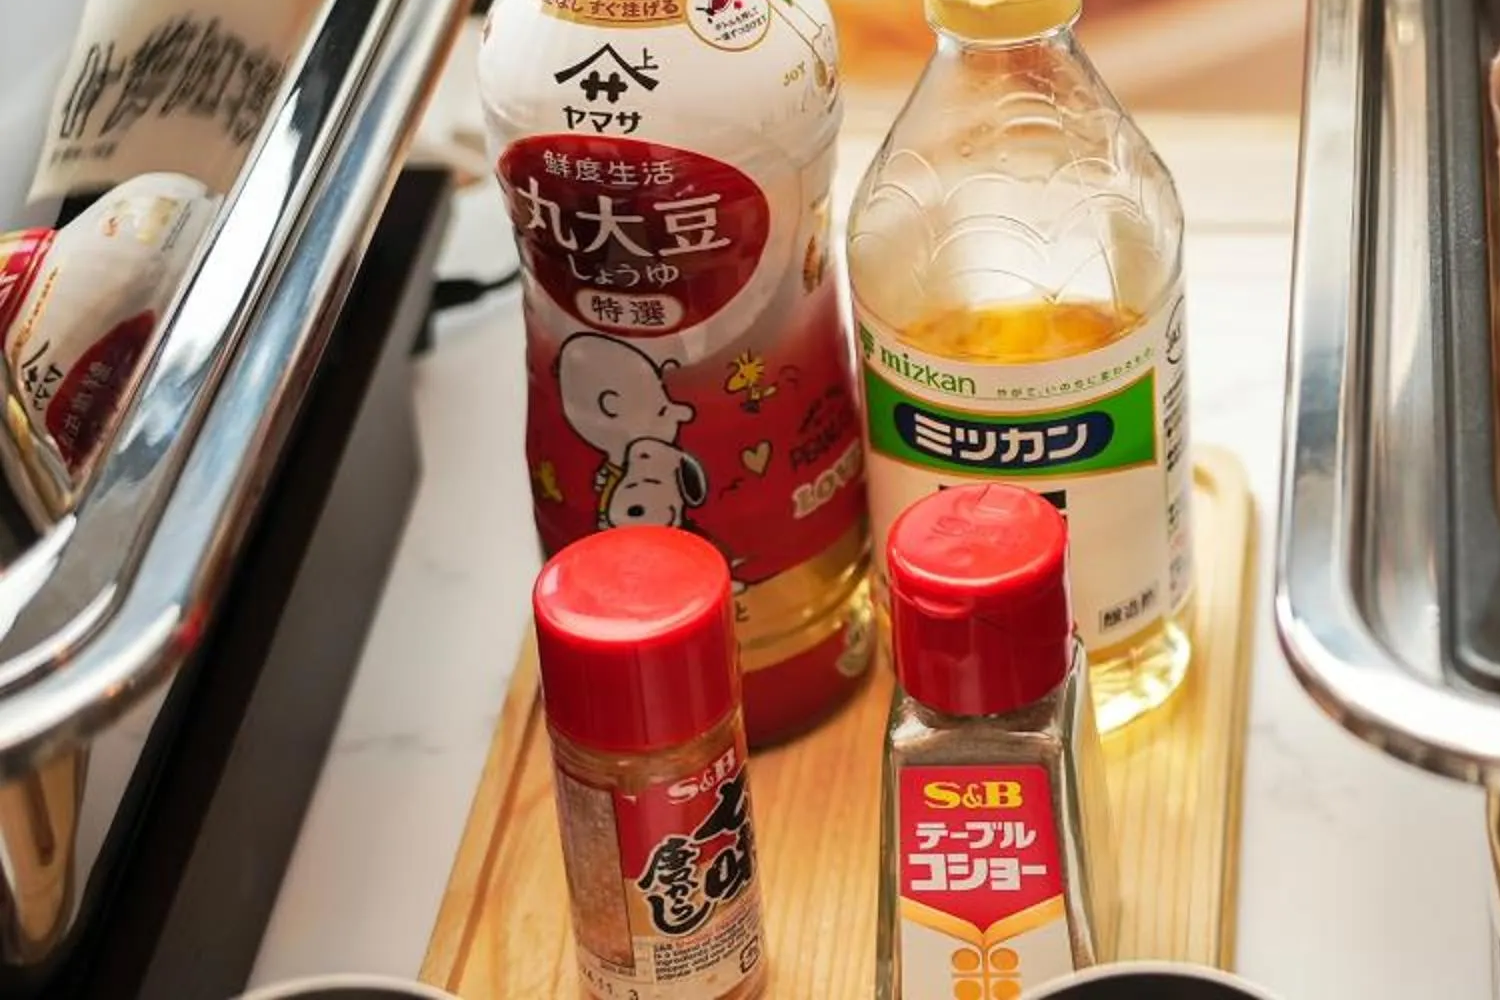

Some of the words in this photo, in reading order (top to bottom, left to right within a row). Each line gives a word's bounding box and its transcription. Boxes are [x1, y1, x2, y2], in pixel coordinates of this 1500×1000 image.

[589, 0, 679, 18] すぐ注げる
[563, 105, 642, 134] ヤマサ
[543, 149, 675, 186] 鮮度生活
[516, 176, 732, 257] 丸大豆
[567, 253, 680, 288] しょうゆ
[591, 295, 666, 326] 特選
[880, 344, 977, 397] mizkan
[913, 412, 1088, 463] ミツカン
[667, 748, 736, 805] S&B
[923, 780, 1024, 809] S&B
[915, 821, 1037, 850] テーブル
[908, 853, 1047, 892] コショー
